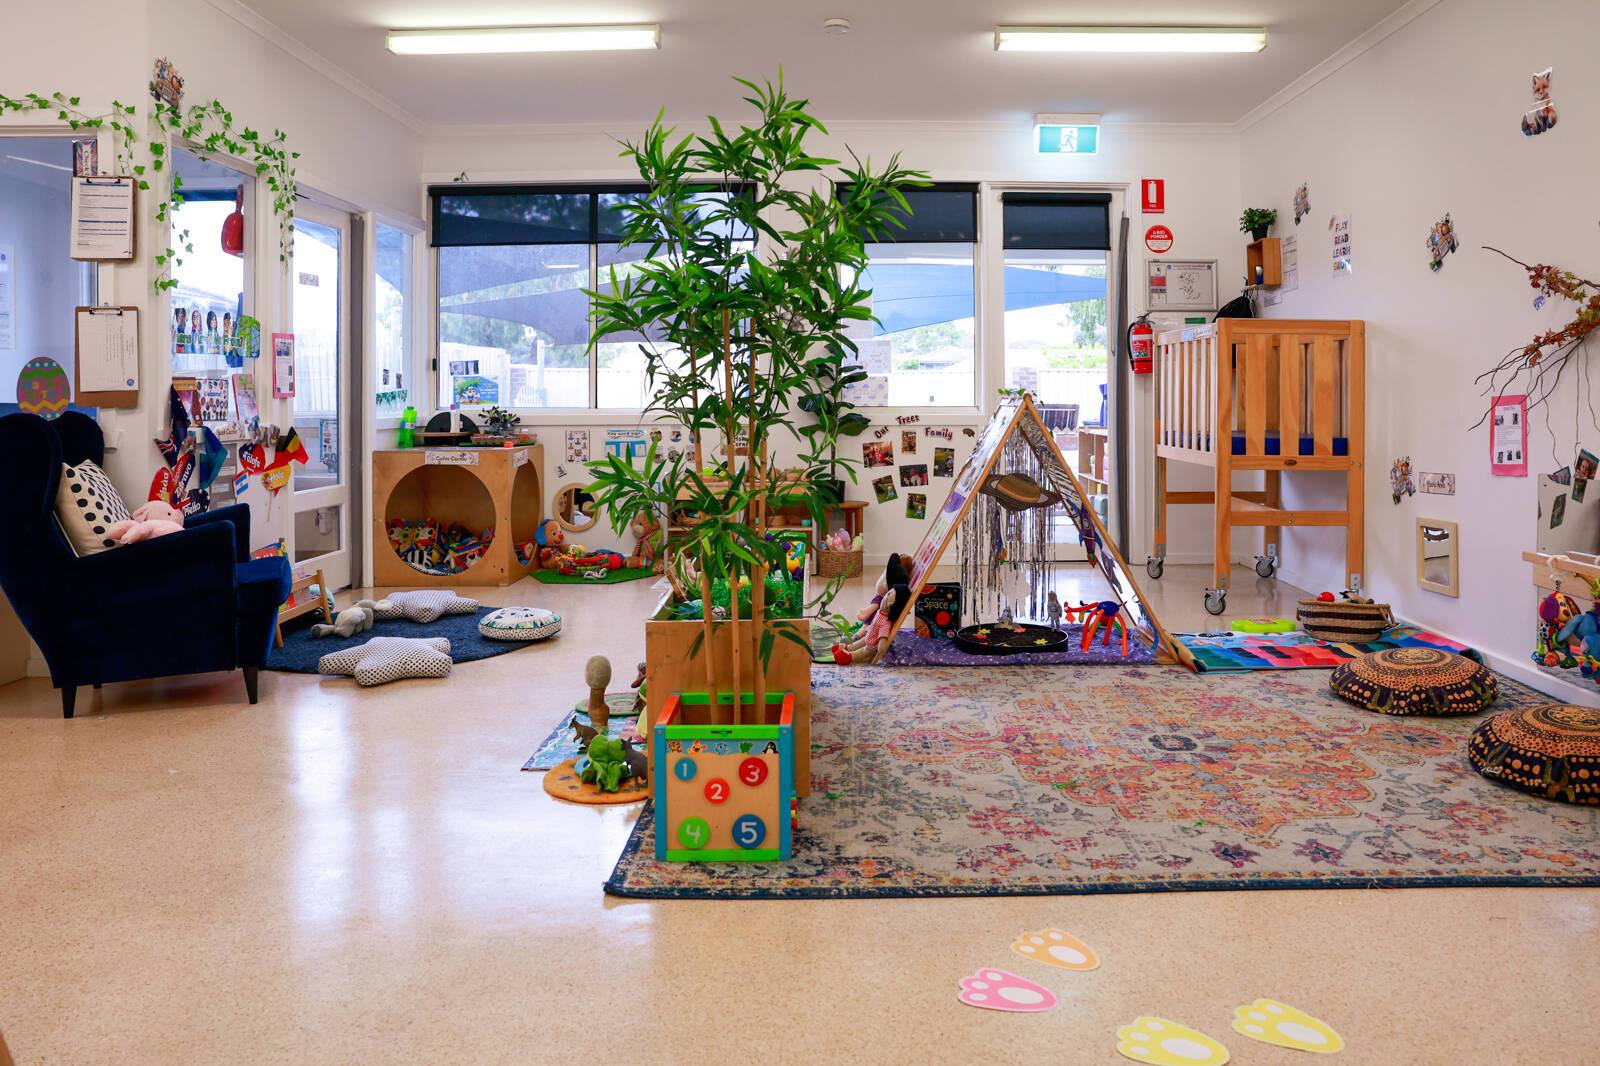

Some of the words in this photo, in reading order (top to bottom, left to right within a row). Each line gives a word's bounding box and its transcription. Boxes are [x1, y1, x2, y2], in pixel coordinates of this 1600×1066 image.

[1335, 221, 1348, 232] PLAY
[1335, 233, 1349, 245] READ
[1333, 246, 1351, 258] LEARN
[873, 425, 889, 439] Our
[896, 414, 920, 425] Trees
[924, 427, 953, 441] Family
[175, 463, 192, 499] Zdravo
[184, 501, 201, 517] Hello
[923, 597, 949, 611] Space
[682, 764, 688, 776] 1
[745, 764, 759, 783] 3
[710, 783, 723, 800] 2
[686, 823, 701, 843] 4
[741, 822, 758, 843] 5
